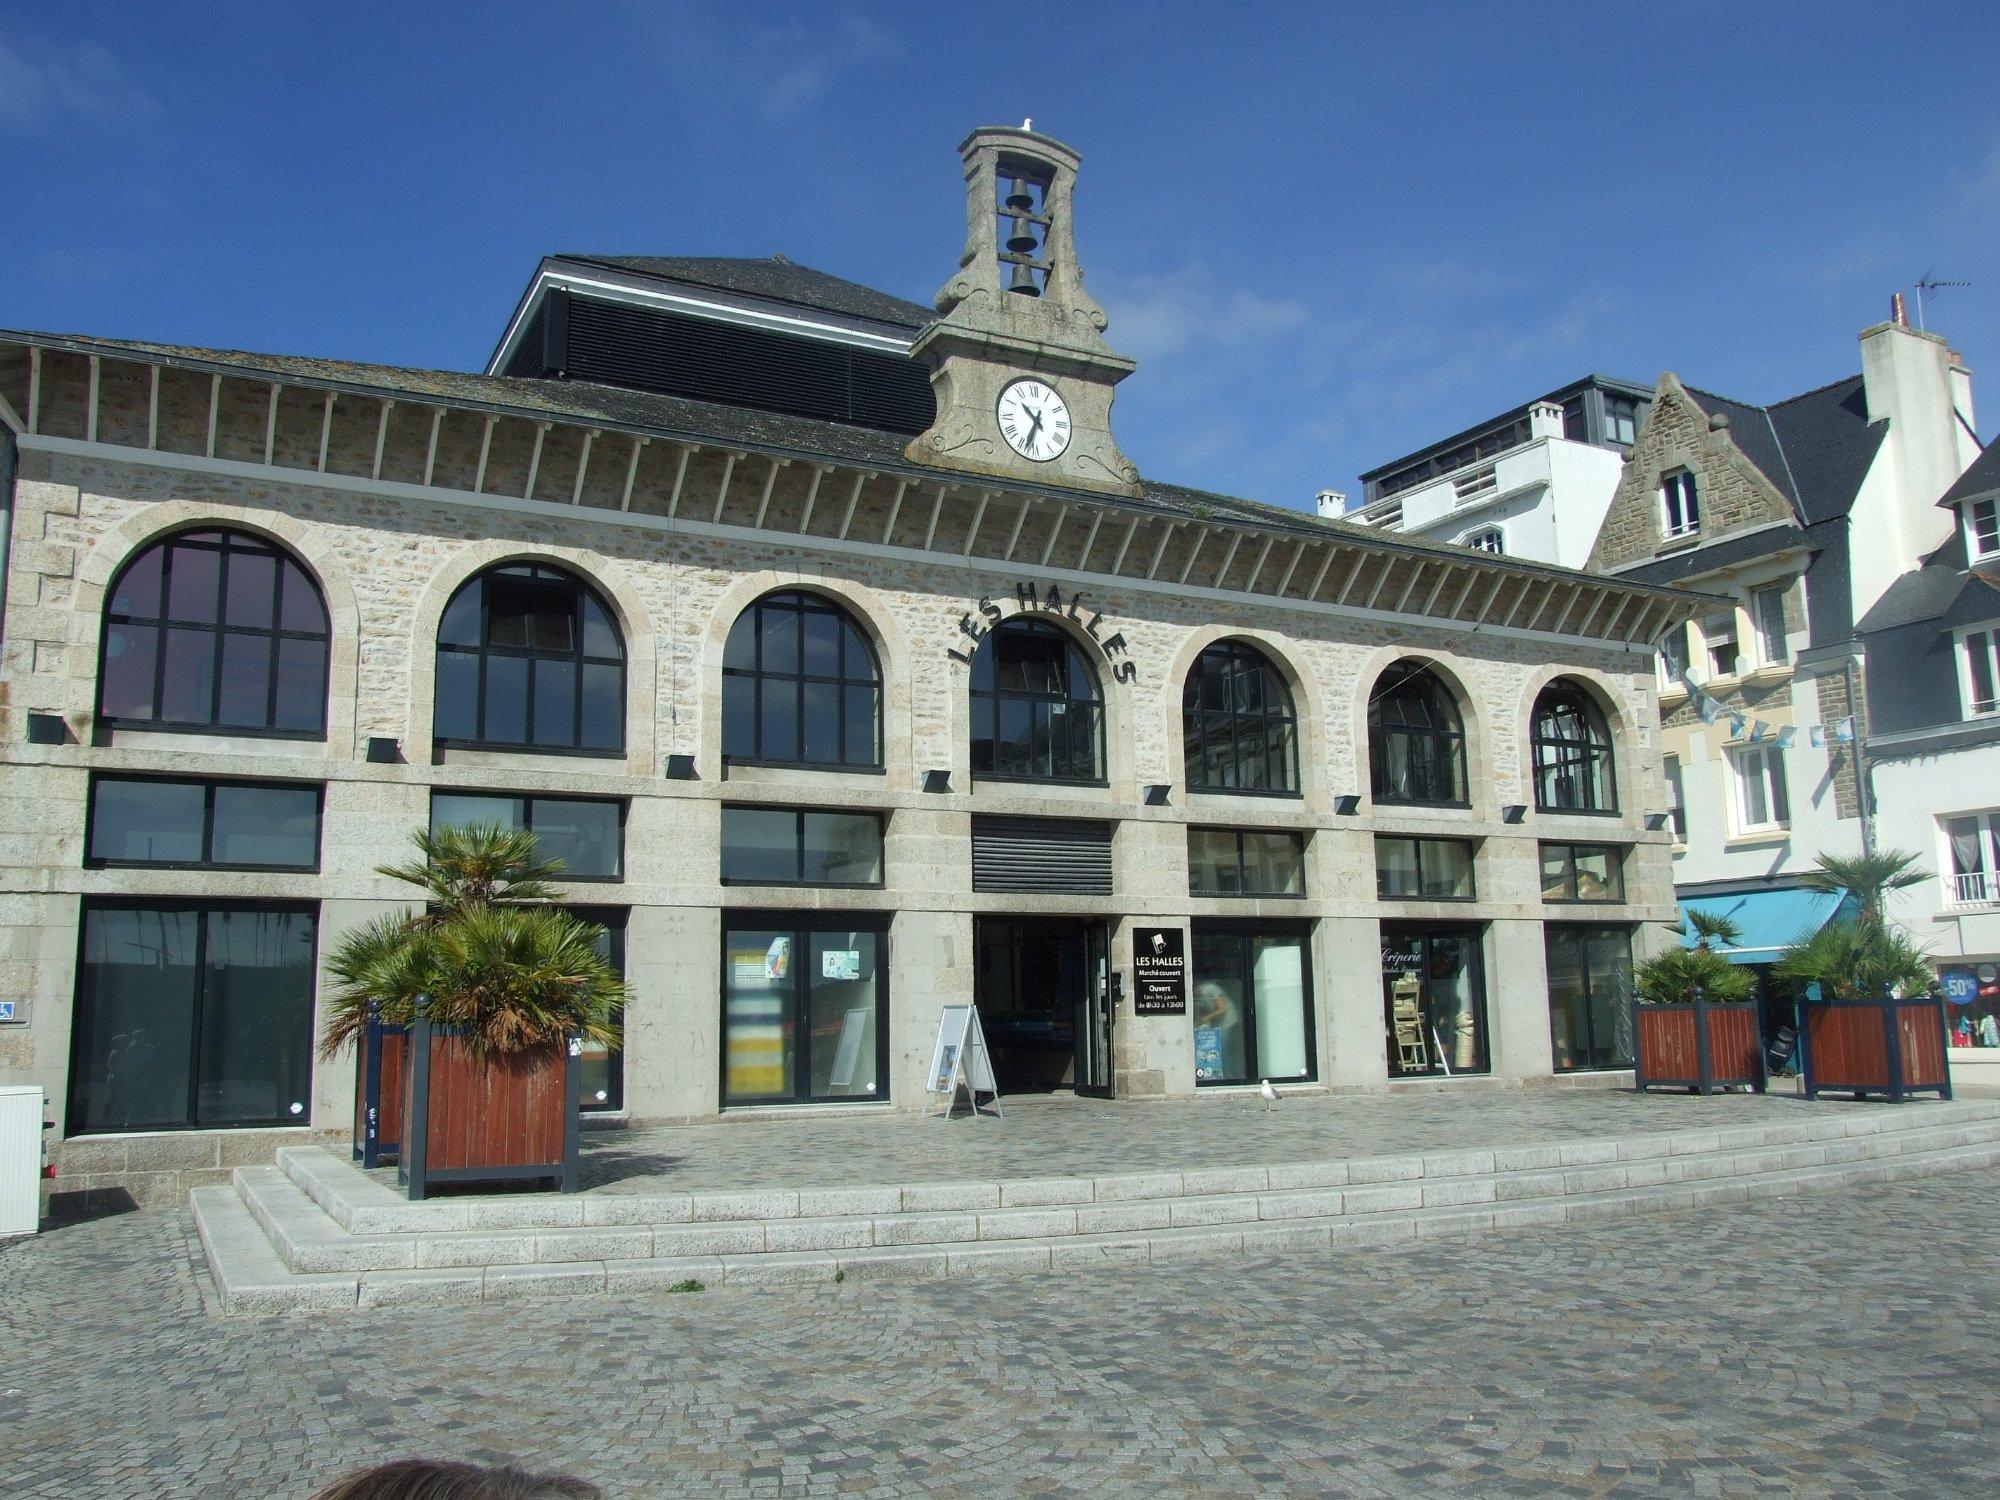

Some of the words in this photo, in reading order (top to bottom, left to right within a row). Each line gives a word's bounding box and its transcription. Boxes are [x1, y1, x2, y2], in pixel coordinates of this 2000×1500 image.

[947, 595, 1002, 665] LES
[1016, 581, 1137, 685] HALLES
[1136, 957, 1150, 966] LES
[1152, 957, 1183, 966] HALLES
[1380, 947, 1422, 967] Crêperie
